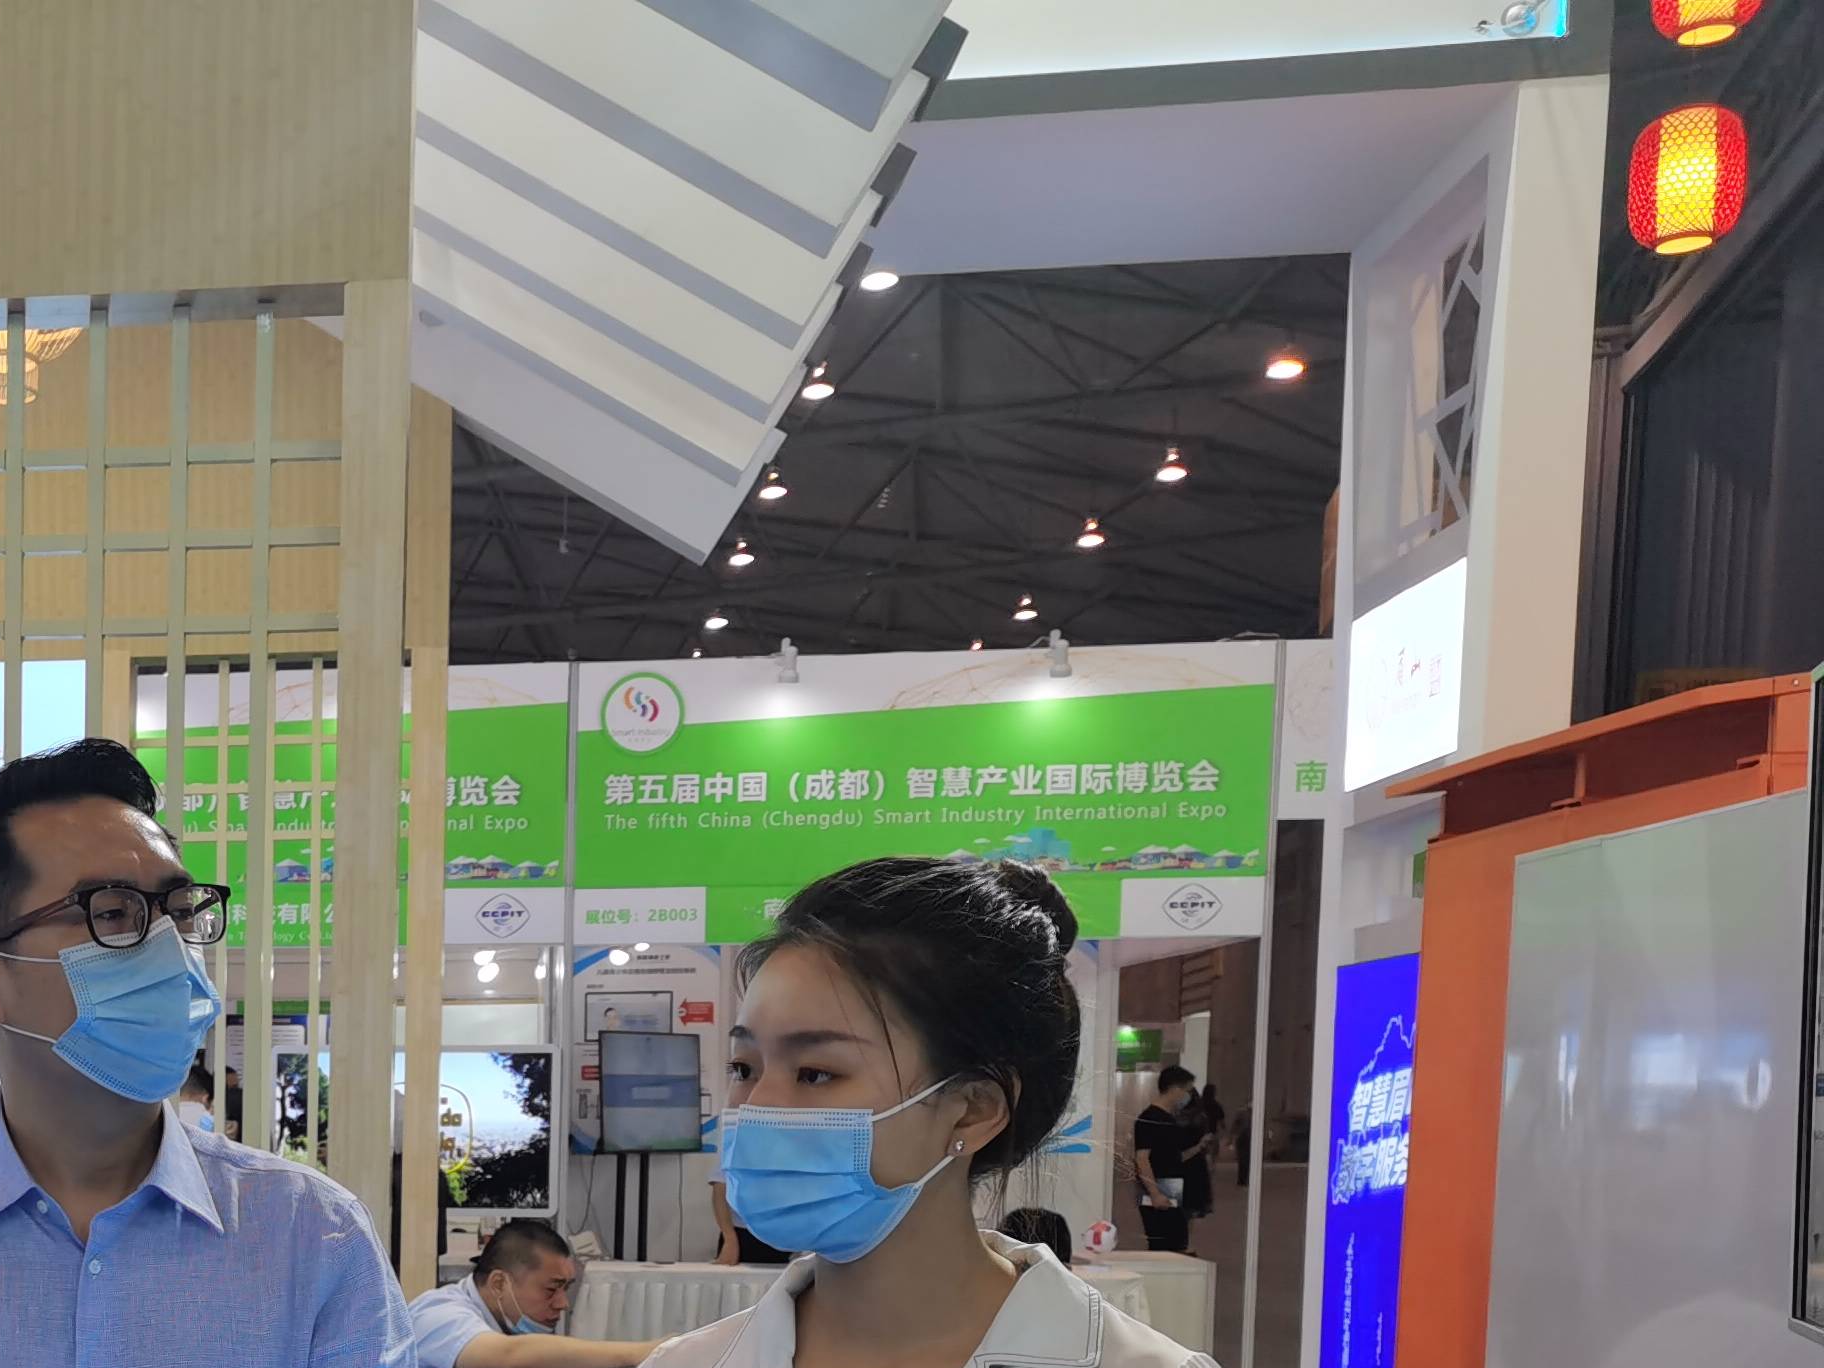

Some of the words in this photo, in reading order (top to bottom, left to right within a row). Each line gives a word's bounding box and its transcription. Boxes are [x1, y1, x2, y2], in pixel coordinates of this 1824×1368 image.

[484, 814, 529, 832] Expo
[605, 814, 638, 830] The
[648, 811, 688, 829] fifth
[698, 811, 751, 829] China
[762, 808, 864, 830] (Chengdu)
[873, 809, 932, 824] Smart
[941, 805, 1025, 826] Industry
[1035, 802, 1168, 822] International
[1178, 801, 1227, 821] Expo
